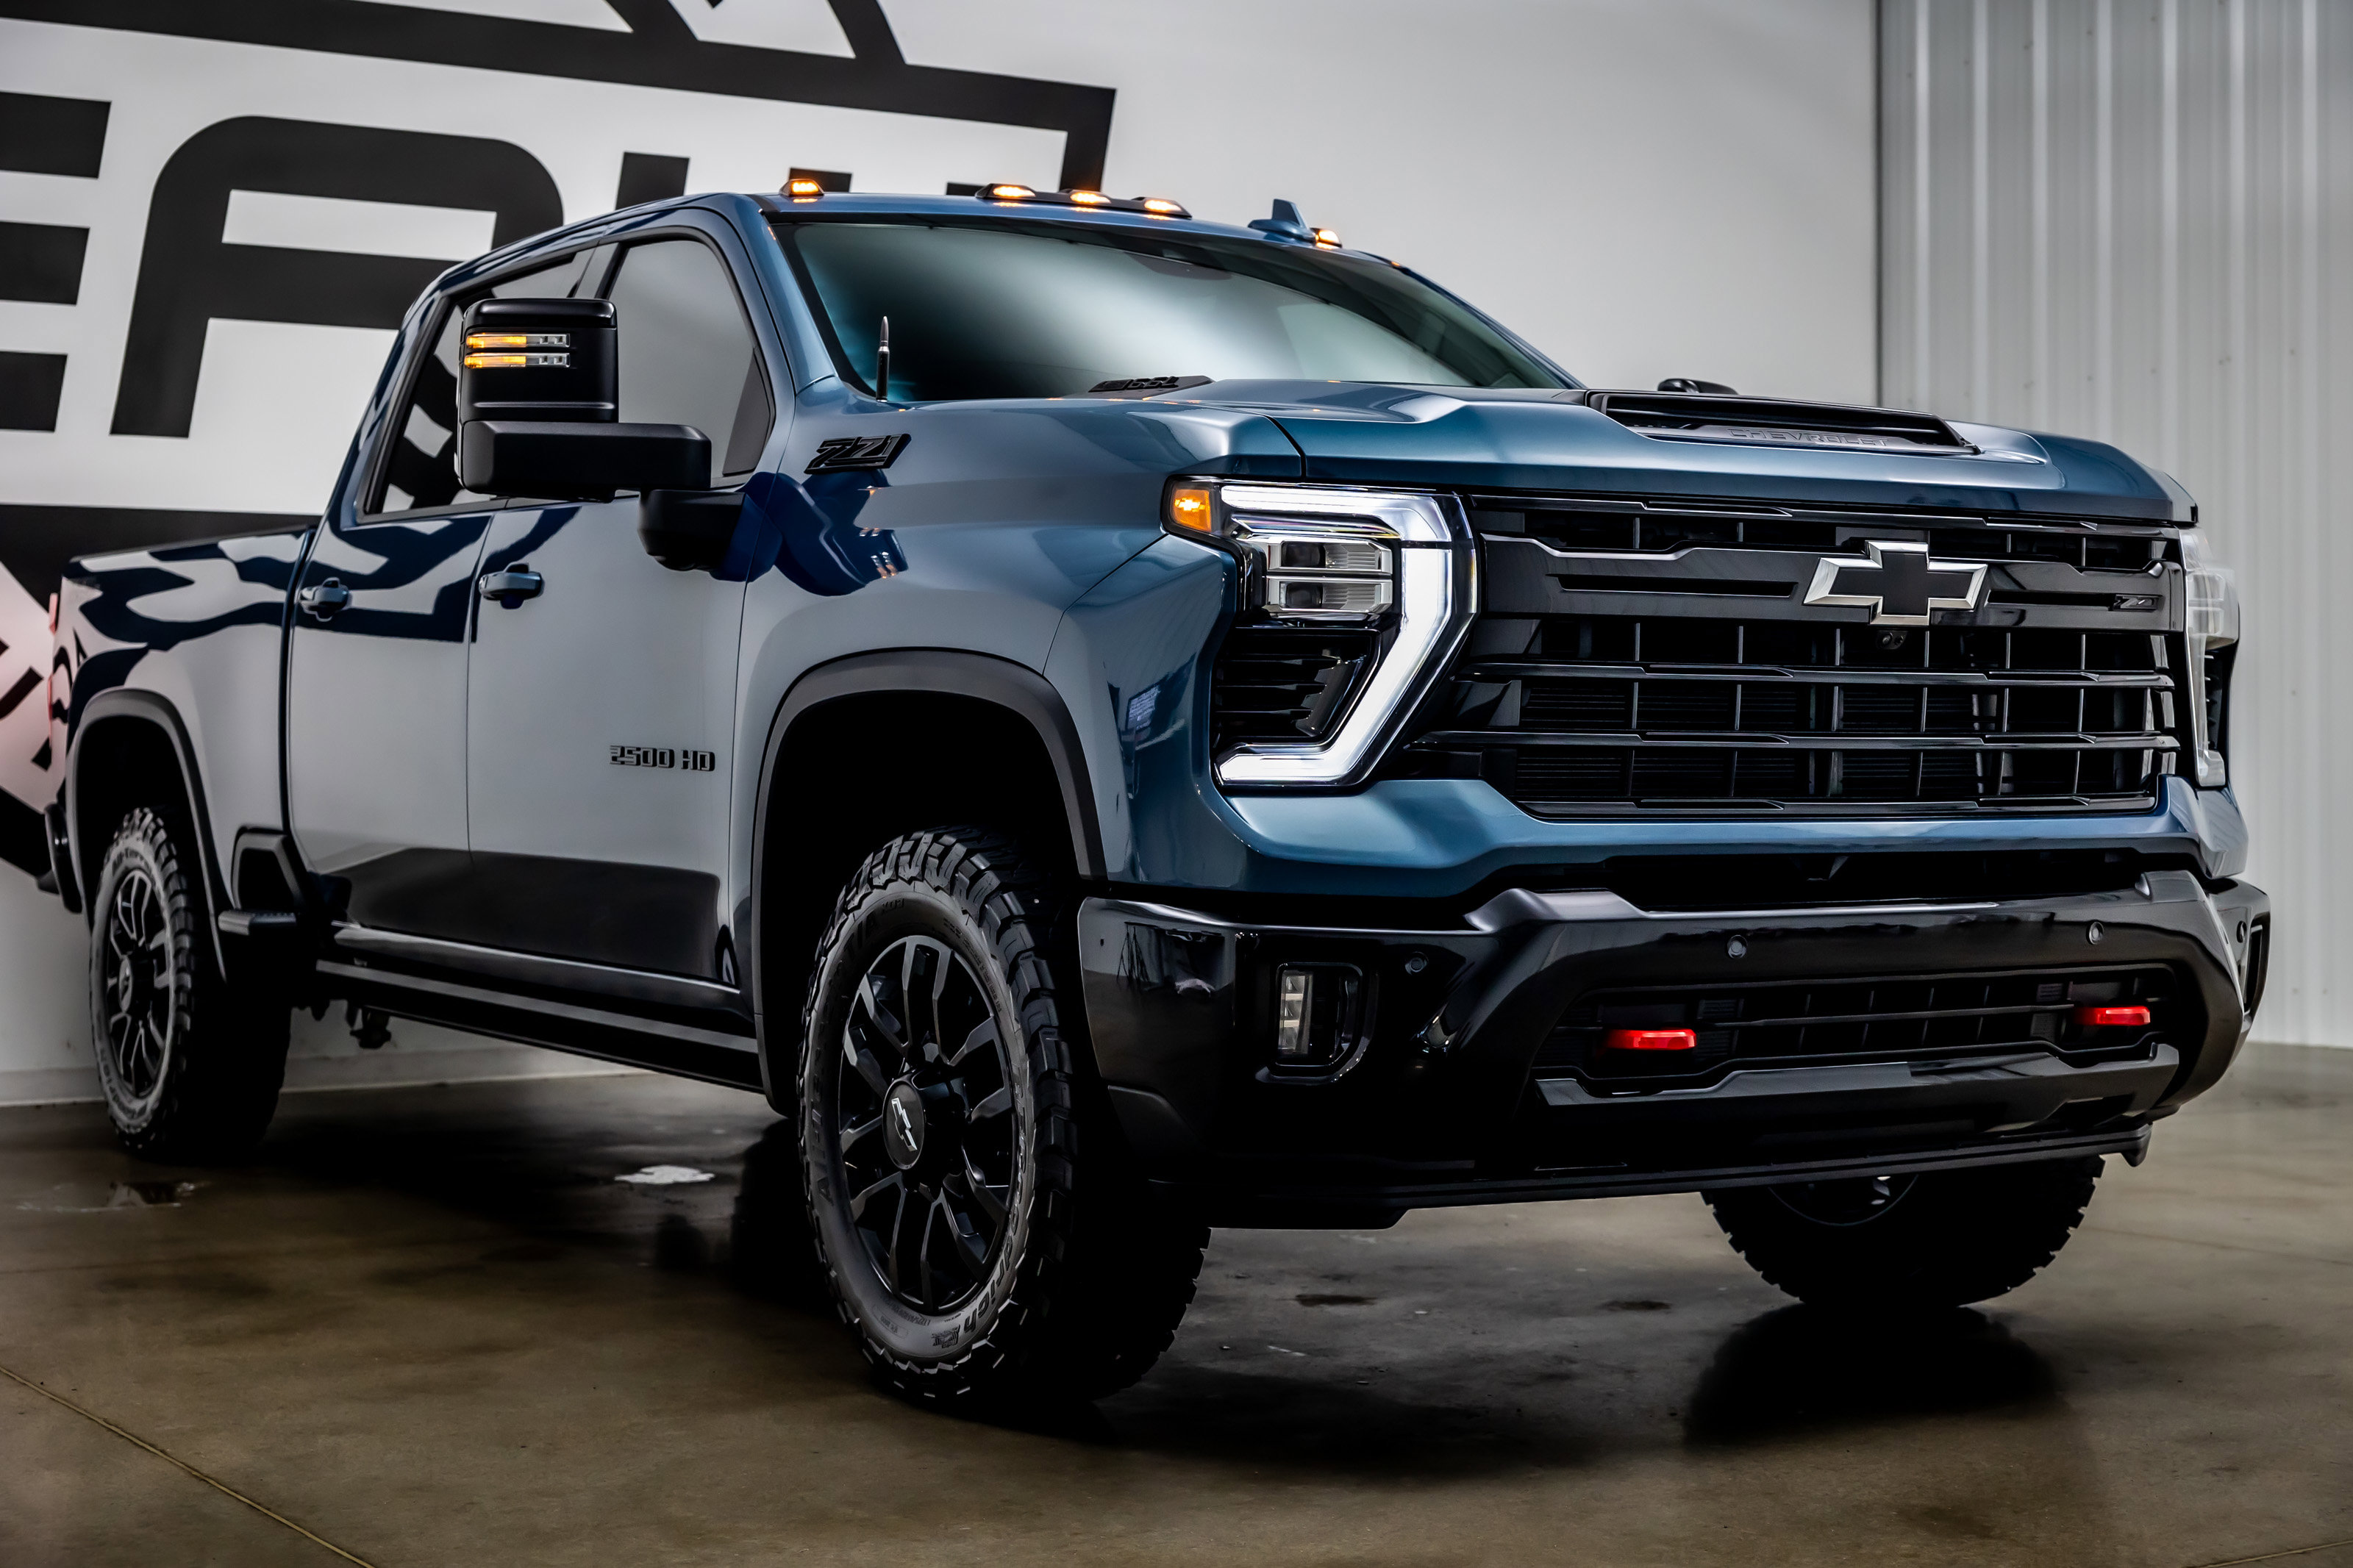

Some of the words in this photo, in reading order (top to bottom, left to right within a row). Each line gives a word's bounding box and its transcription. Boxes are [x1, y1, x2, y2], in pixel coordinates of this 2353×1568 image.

[1728, 429, 1888, 446] CHEVROLET
[804, 434, 911, 474] Z71
[610, 745, 675, 768] 2500
[681, 749, 715, 772] HD
